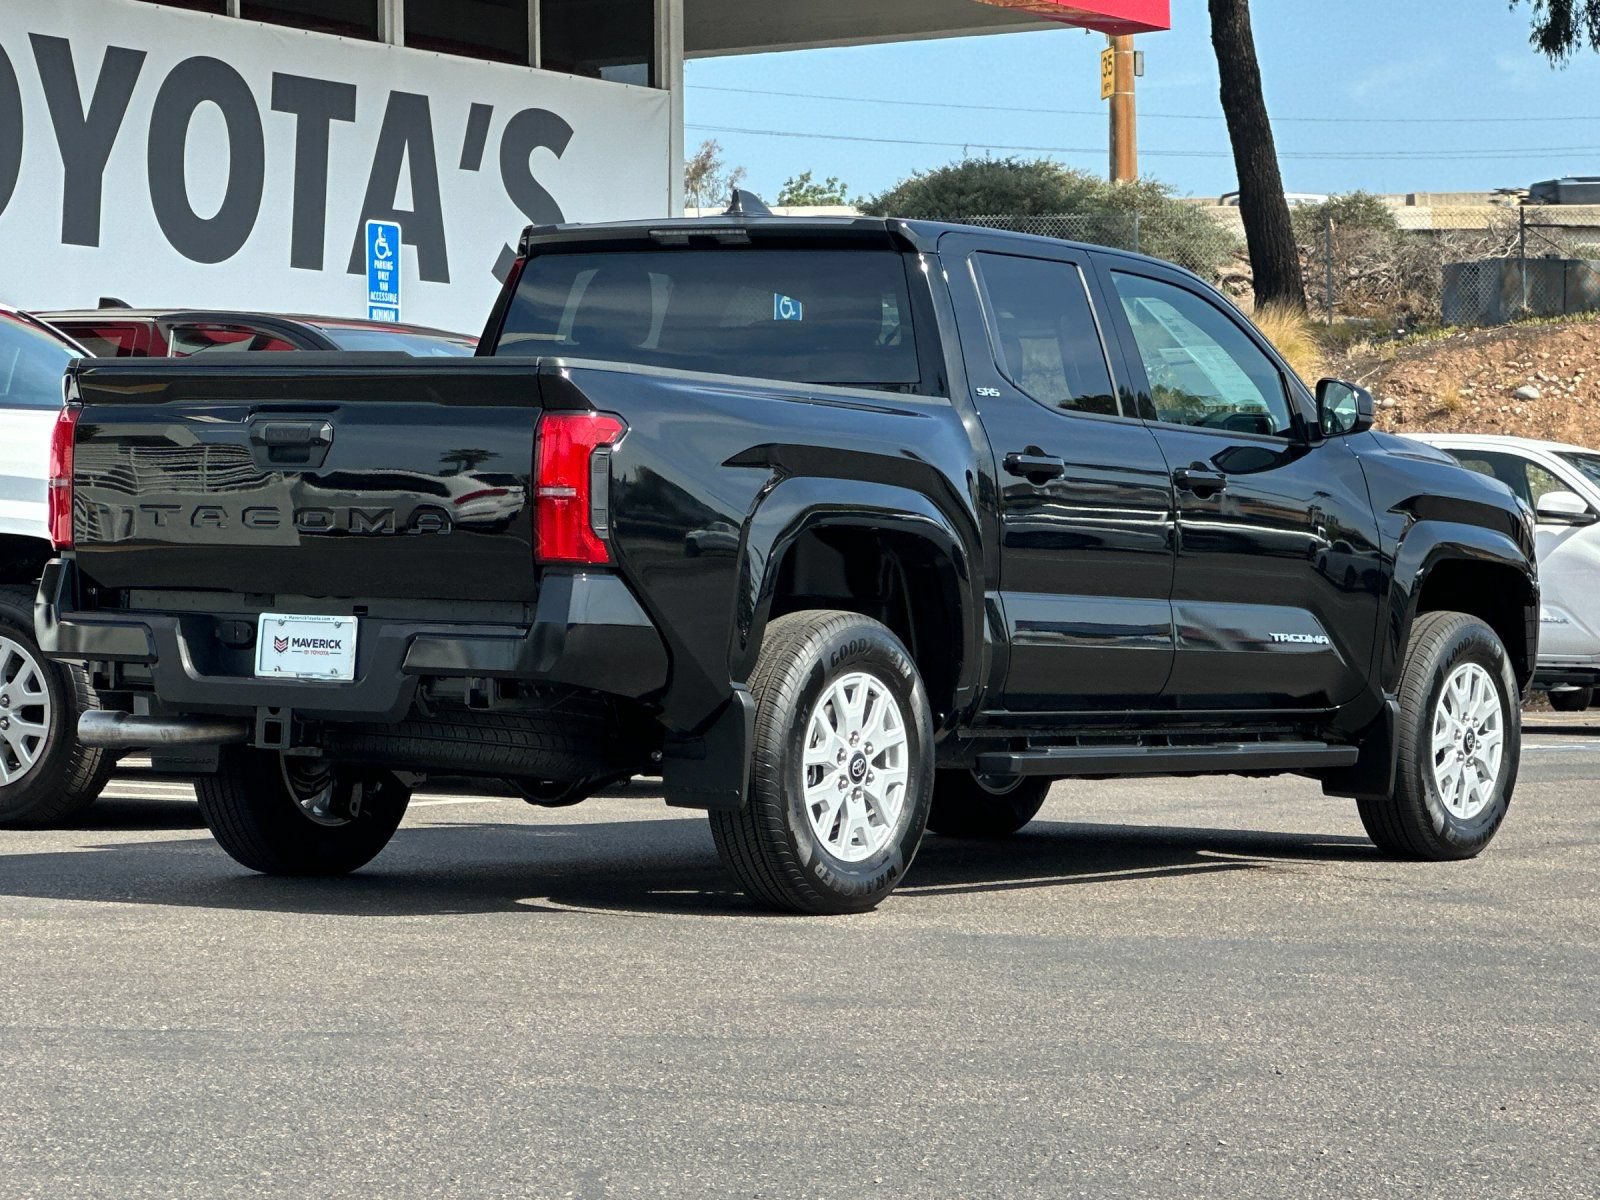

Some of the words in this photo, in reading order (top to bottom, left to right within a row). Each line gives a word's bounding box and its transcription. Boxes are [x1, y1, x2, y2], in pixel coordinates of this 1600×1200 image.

[1102, 54, 1113, 78] 35
[0, 32, 574, 286] YOTA'S
[373, 259, 394, 271] PARKING
[377, 270, 390, 281] ONLY
[379, 281, 389, 292] VAN
[370, 291, 398, 303] ACCESSIBLE
[140, 504, 452, 534] TACOMA
[291, 637, 342, 650] MAVERICK
[1268, 632, 1330, 644] TACOMA
